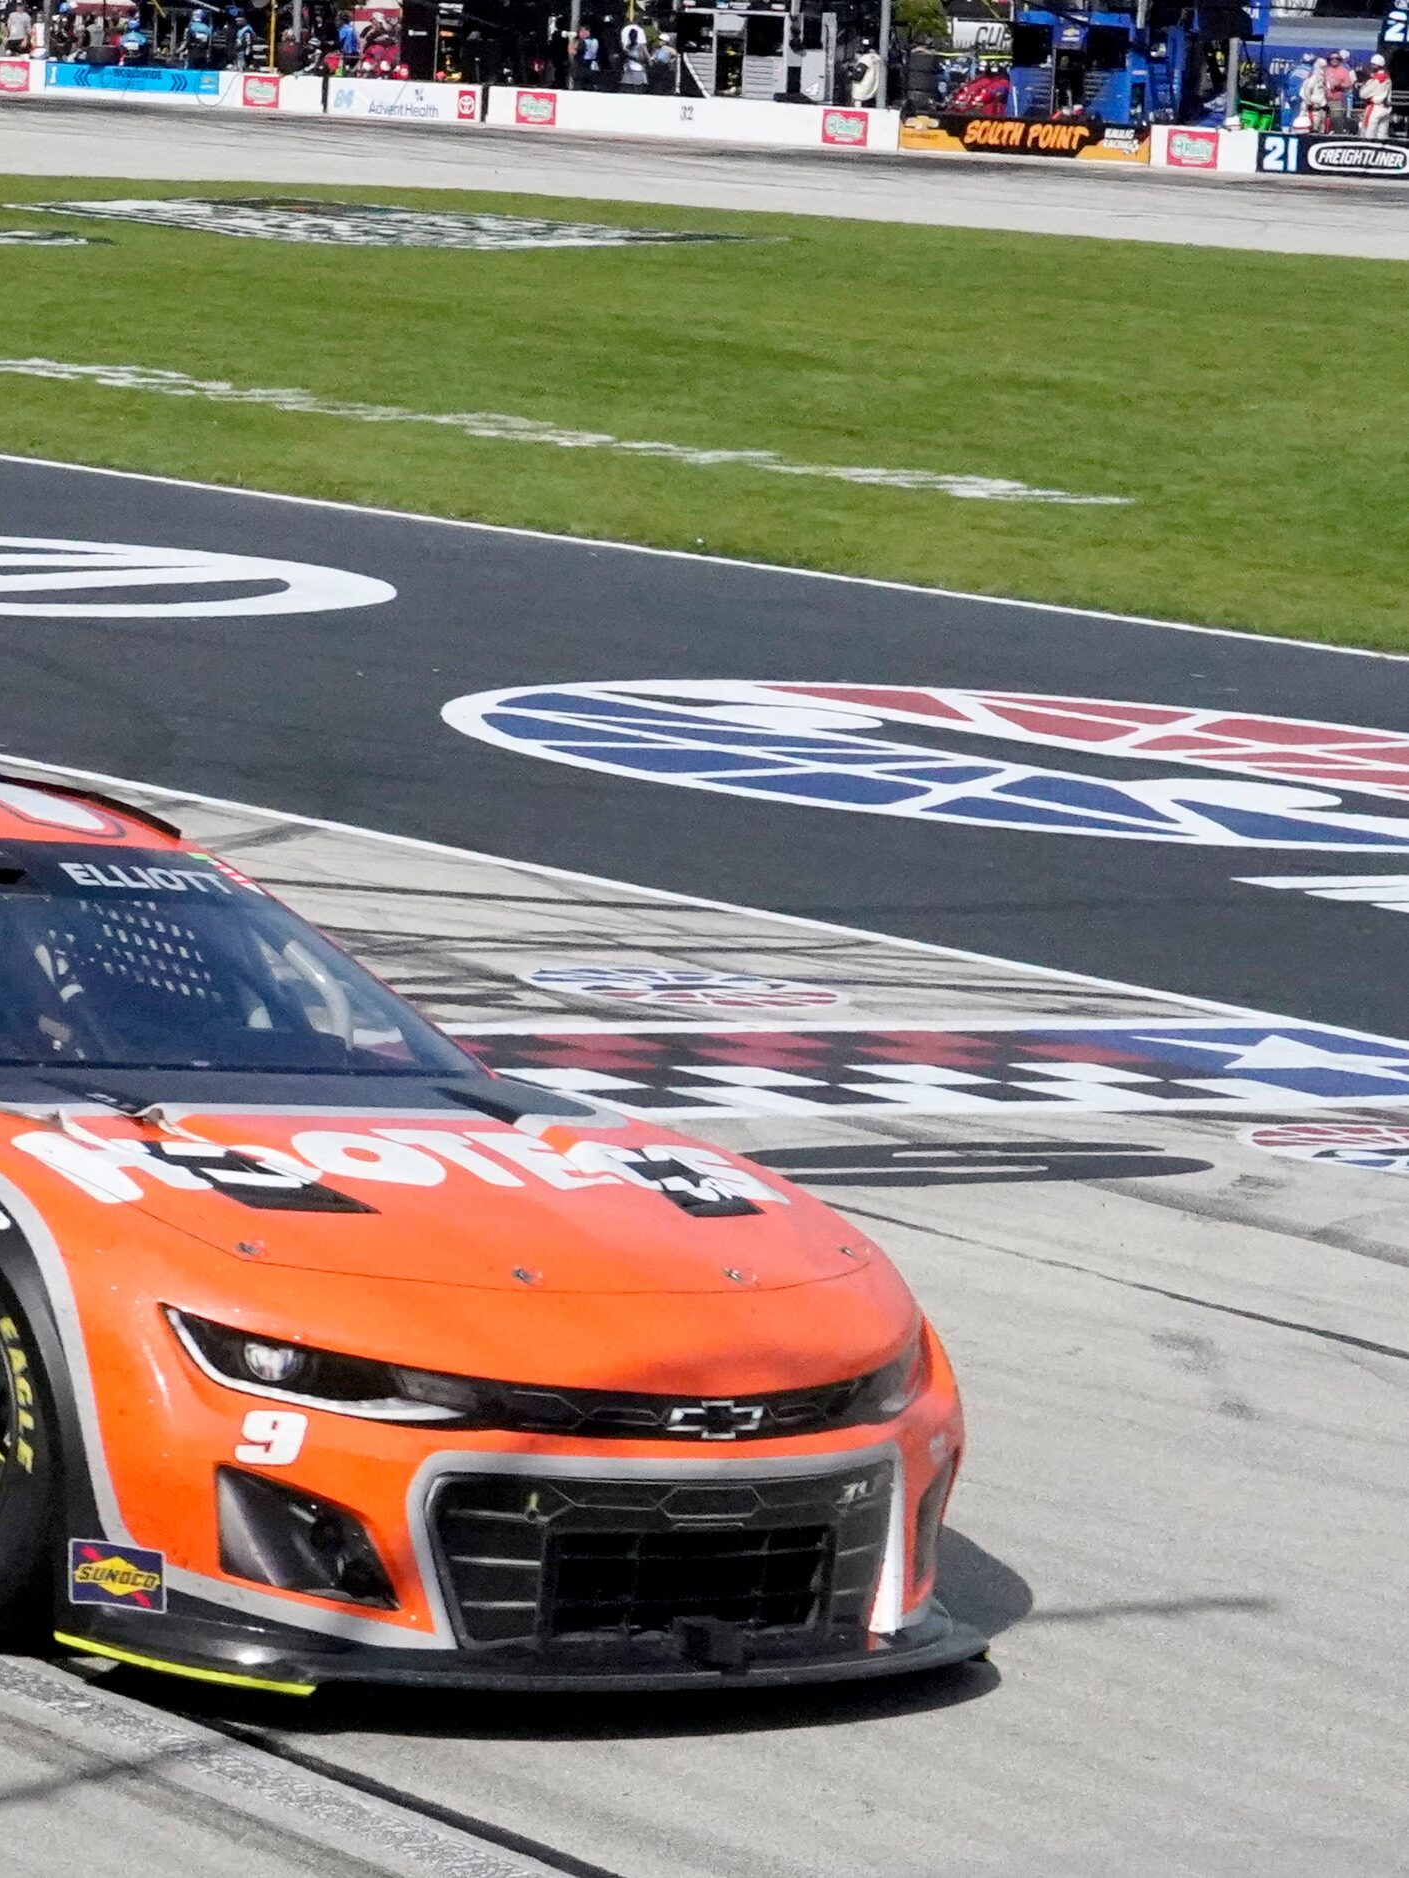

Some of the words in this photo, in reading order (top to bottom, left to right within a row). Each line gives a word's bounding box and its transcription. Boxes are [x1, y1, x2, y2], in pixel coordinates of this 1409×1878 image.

[50, 66, 57, 84] 1
[334, 89, 355, 109] 84
[680, 105, 694, 121] 32
[964, 120, 1025, 146] SOUTH
[1027, 123, 1090, 150] POINT
[1263, 136, 1299, 172] 21
[1318, 148, 1405, 168] FREIGHTLINER
[58, 862, 233, 895] ELLIOTT
[234, 1410, 308, 1466] 9
[78, 1565, 158, 1589] SUNOCO
